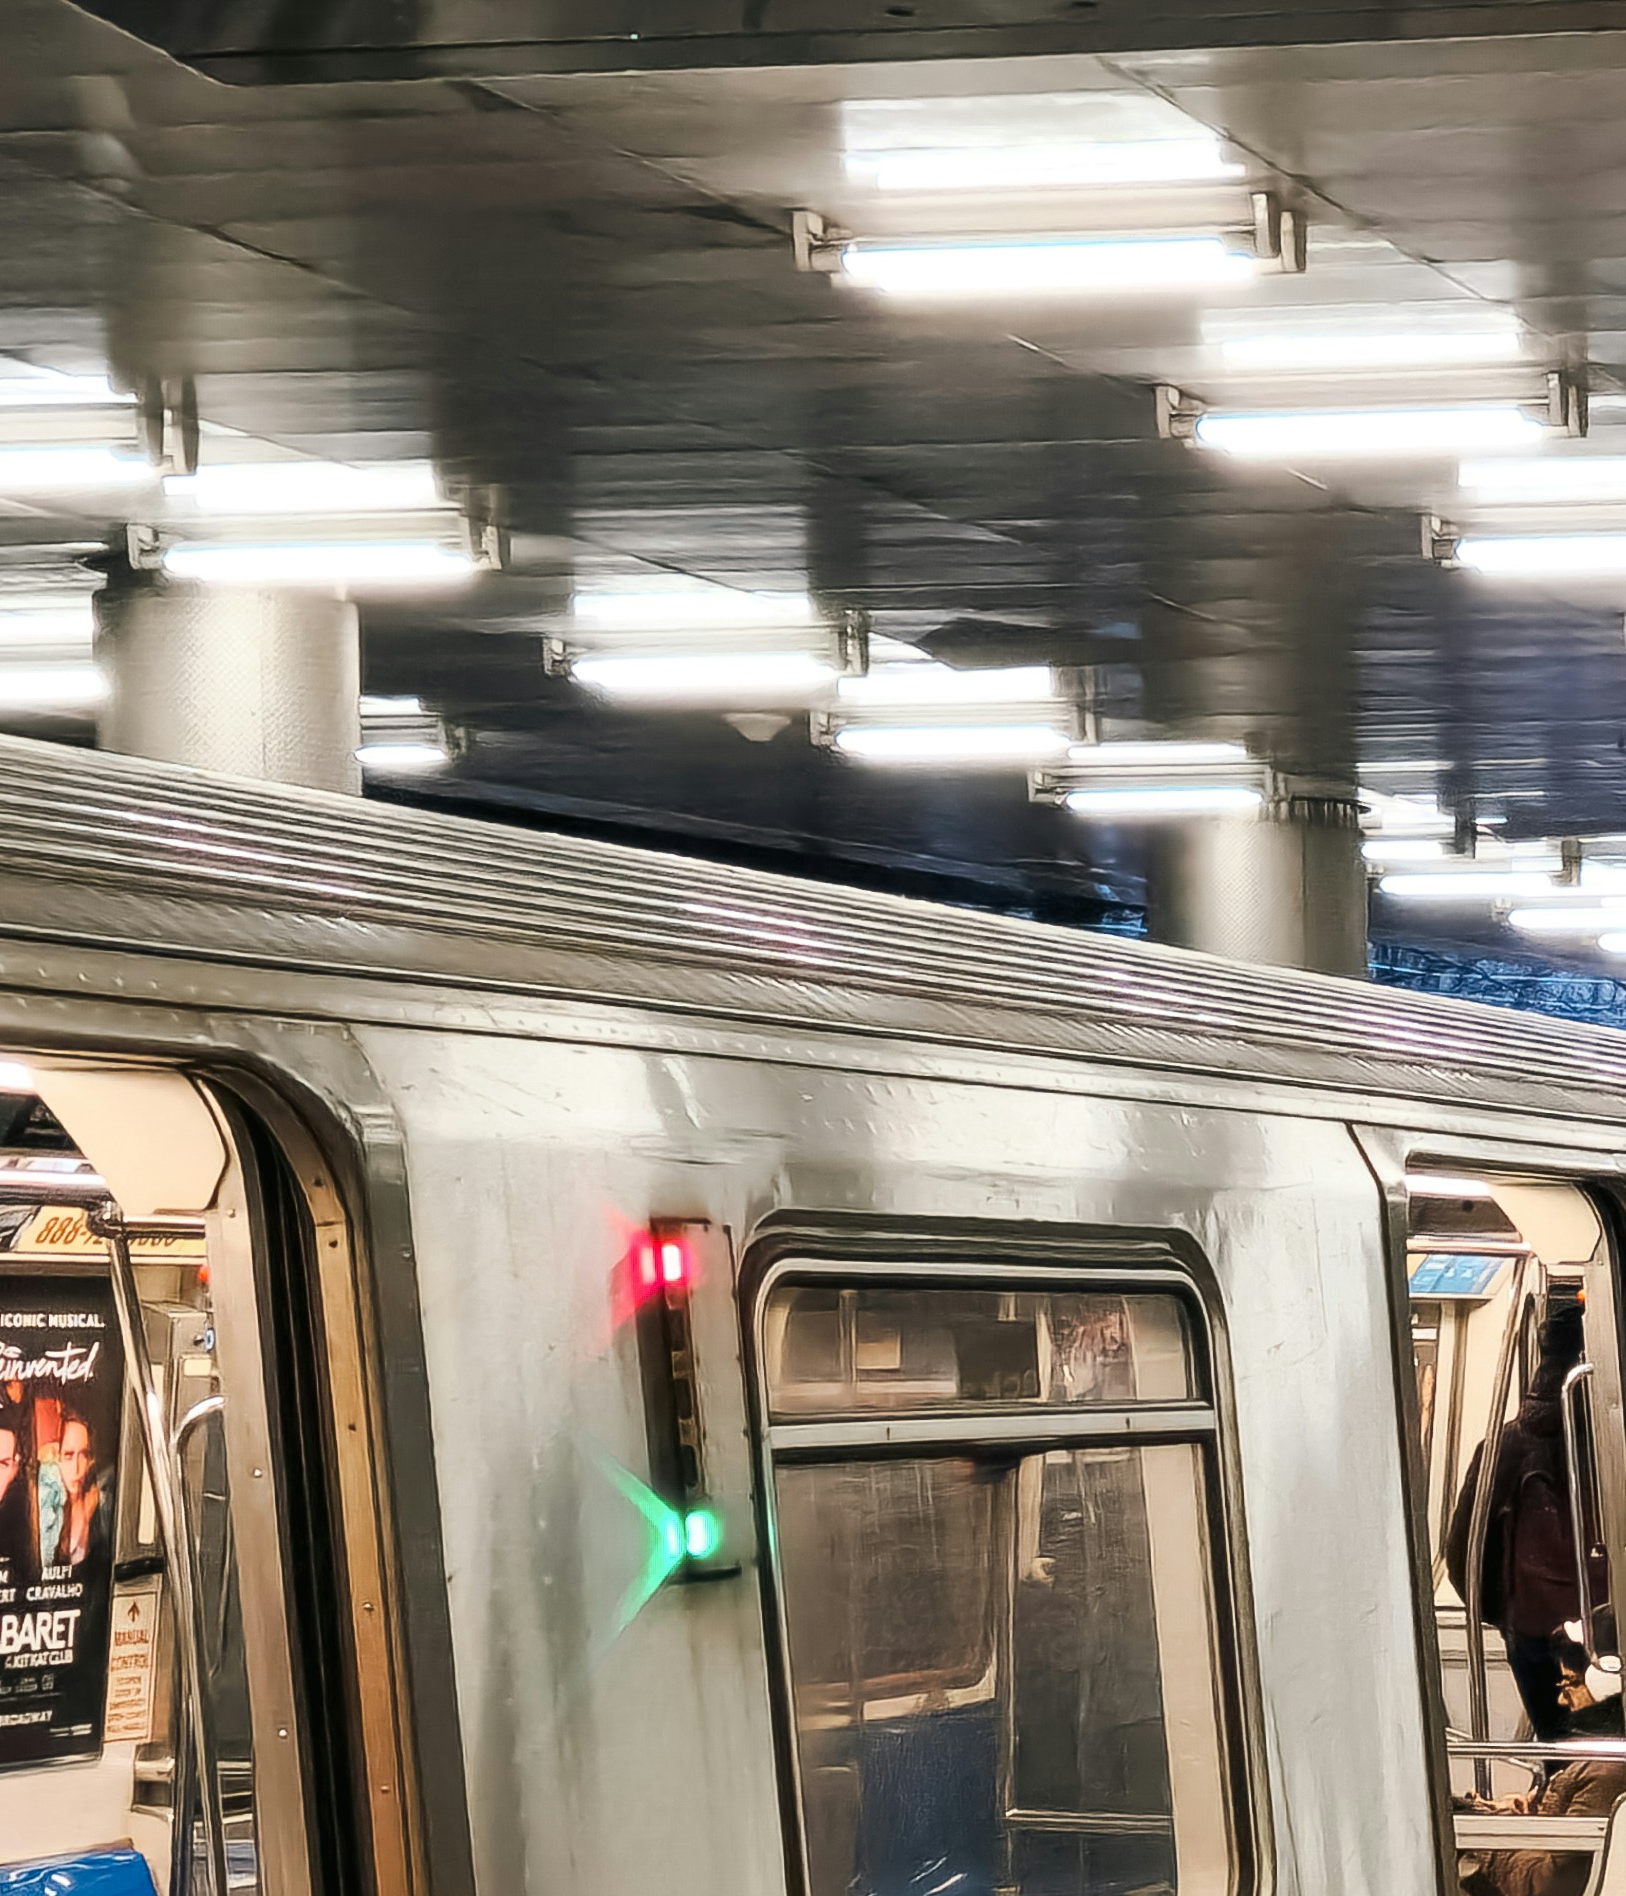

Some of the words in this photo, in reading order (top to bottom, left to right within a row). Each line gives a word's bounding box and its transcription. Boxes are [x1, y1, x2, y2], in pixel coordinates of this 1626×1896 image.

[0, 1312, 47, 1328] ICONIC
[48, 1312, 106, 1328] MUSICAL.
[26, 1583, 84, 1602] CRAVALHO
